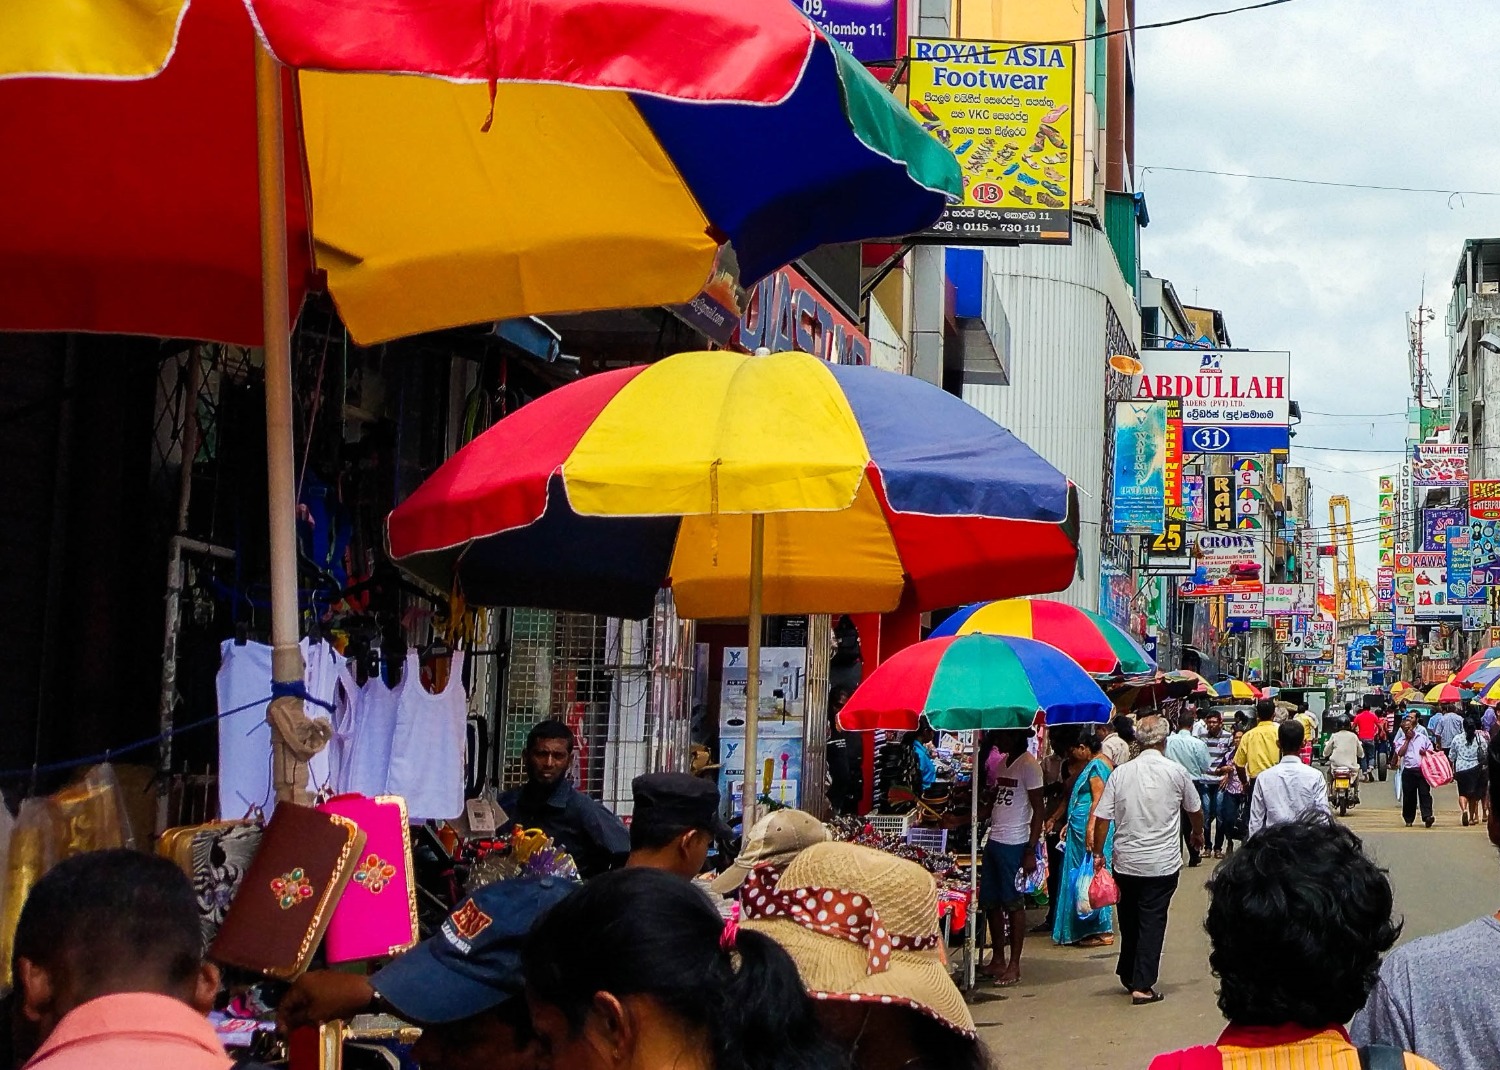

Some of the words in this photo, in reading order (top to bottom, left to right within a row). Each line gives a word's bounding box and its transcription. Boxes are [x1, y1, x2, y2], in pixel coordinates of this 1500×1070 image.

[818, 21, 866, 35] olombo
[869, 23, 886, 36] 11.
[916, 42, 996, 65] ROYAL
[1004, 46, 1065, 68] ASIA
[933, 66, 1048, 90] Footwear
[968, 110, 990, 120] VKC
[977, 187, 999, 200] 13
[963, 223, 989, 231] 0115
[1000, 224, 1022, 232] 730
[1025, 225, 1041, 233] 111
[1136, 375, 1285, 399] ABDULLAH
[1210, 400, 1229, 408] (PVT)
[1201, 429, 1221, 448] 31
[1421, 446, 1468, 454] UNLIMITED
[1380, 478, 1393, 564] RAMYA
[1152, 524, 1181, 550] 25
[1199, 535, 1255, 549] CROWN
